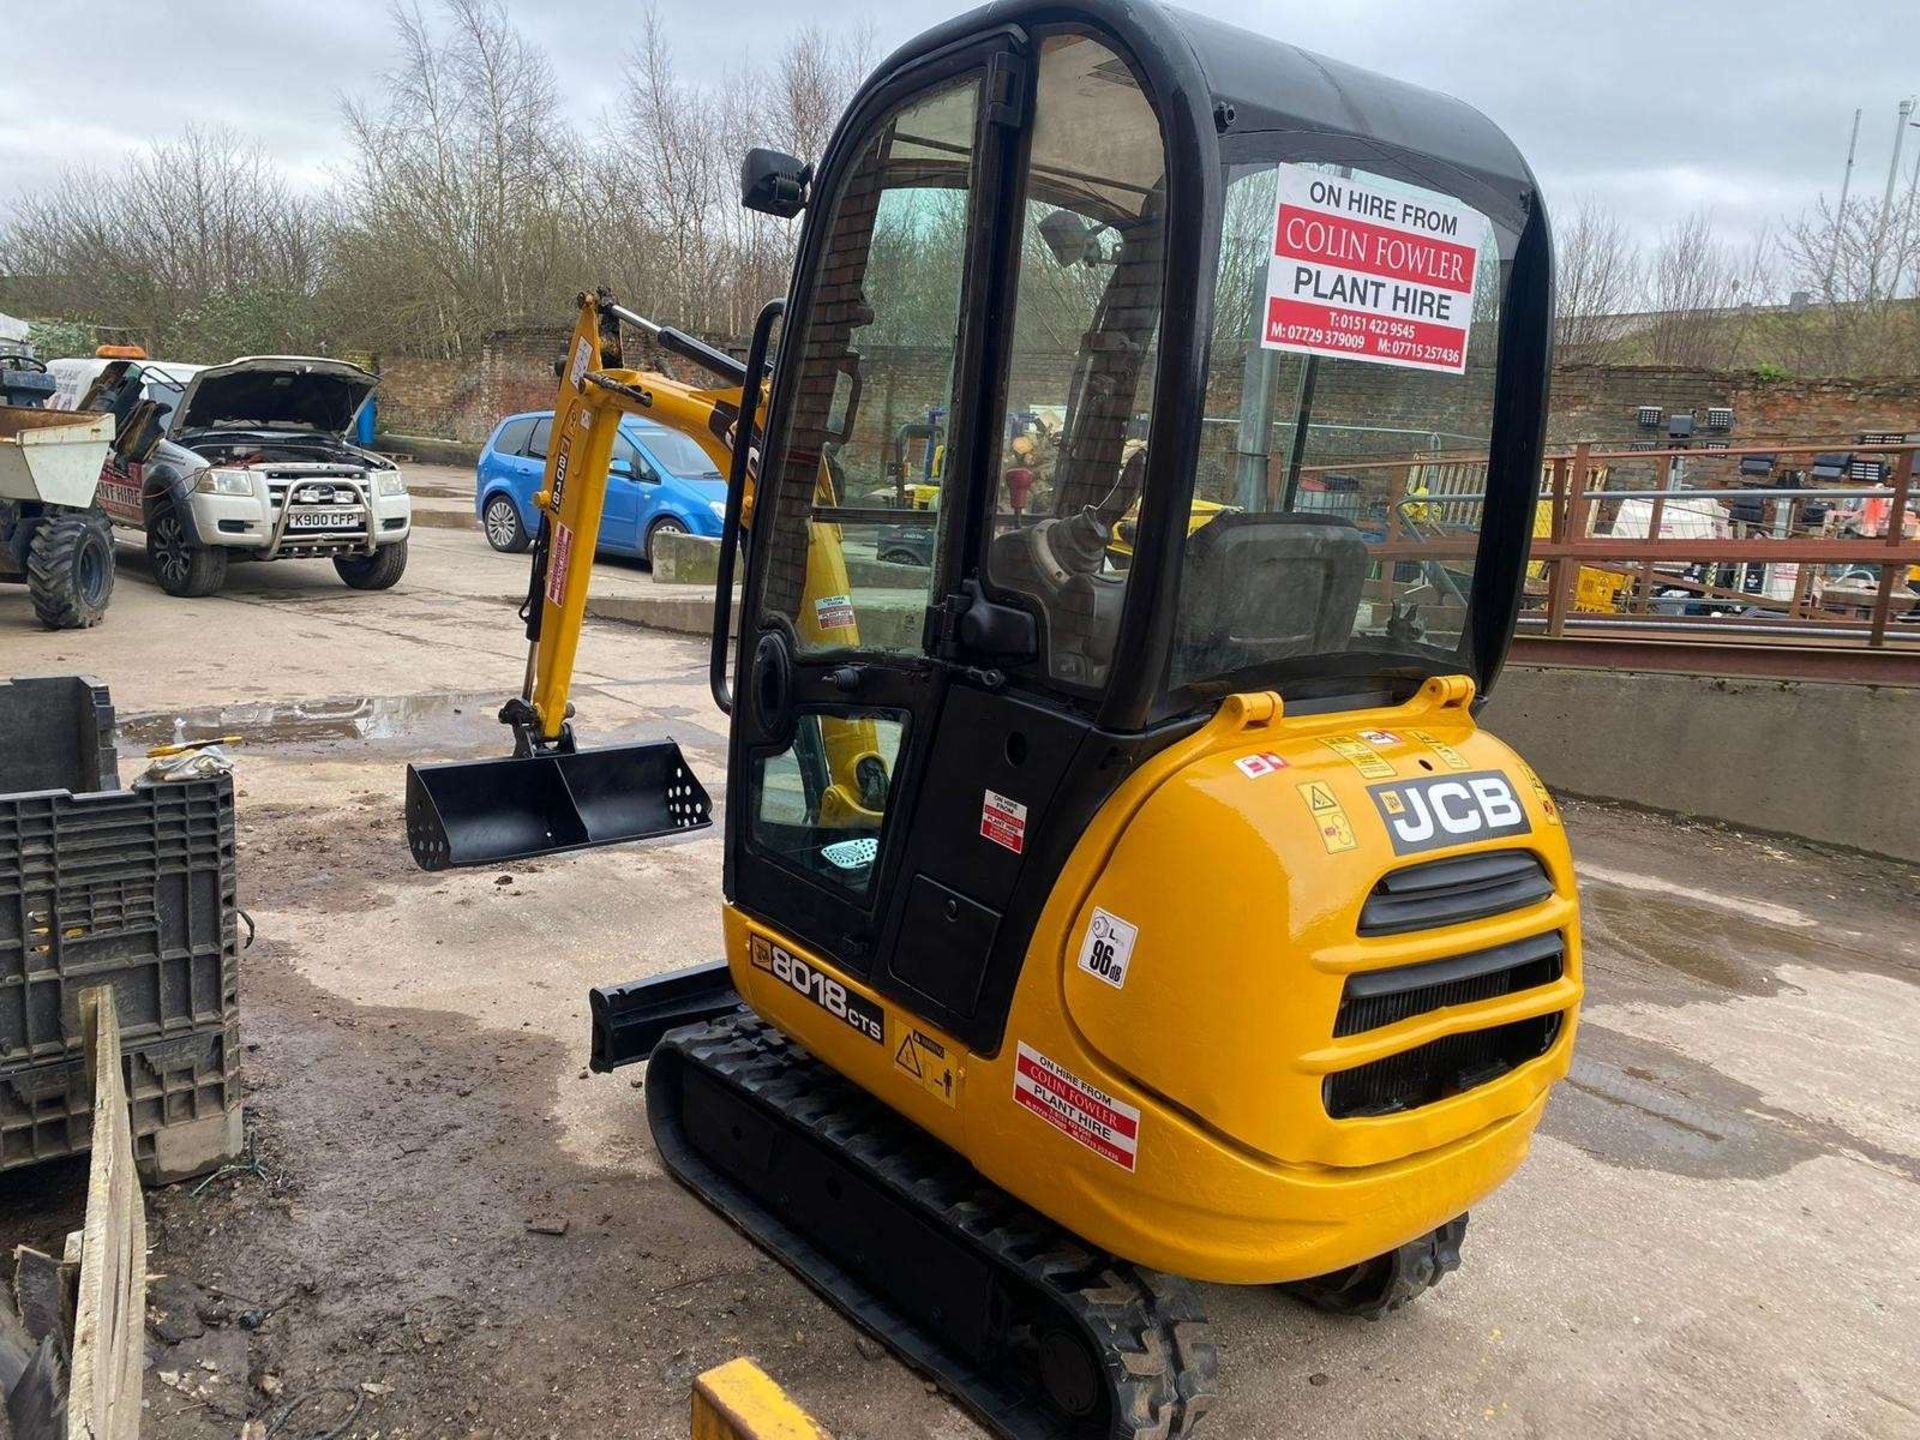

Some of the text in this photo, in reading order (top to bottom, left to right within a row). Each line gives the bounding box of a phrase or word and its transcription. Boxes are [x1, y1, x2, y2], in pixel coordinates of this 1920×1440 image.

[1310, 181, 1458, 236] ON HIRE FROM
[1286, 217, 1465, 284] COLIN FOWLER
[1293, 266, 1452, 321] PLANT HIRE
[1288, 324, 1323, 343] 07729
[1325, 330, 1365, 349] 379009
[294, 514, 354, 526] K900 CFP
[1393, 777, 1523, 843] JCB
[772, 946, 847, 1019] 8018
[847, 1008, 882, 1041] CTS
[1030, 1065, 1066, 1097] COLIN
[1069, 1088, 1118, 1129] FOWLER
[1039, 1056, 1112, 1107] ON HIRE FROM
[1034, 1084, 1076, 1118] PLANT
[1078, 1112, 1112, 1141] HIRE
